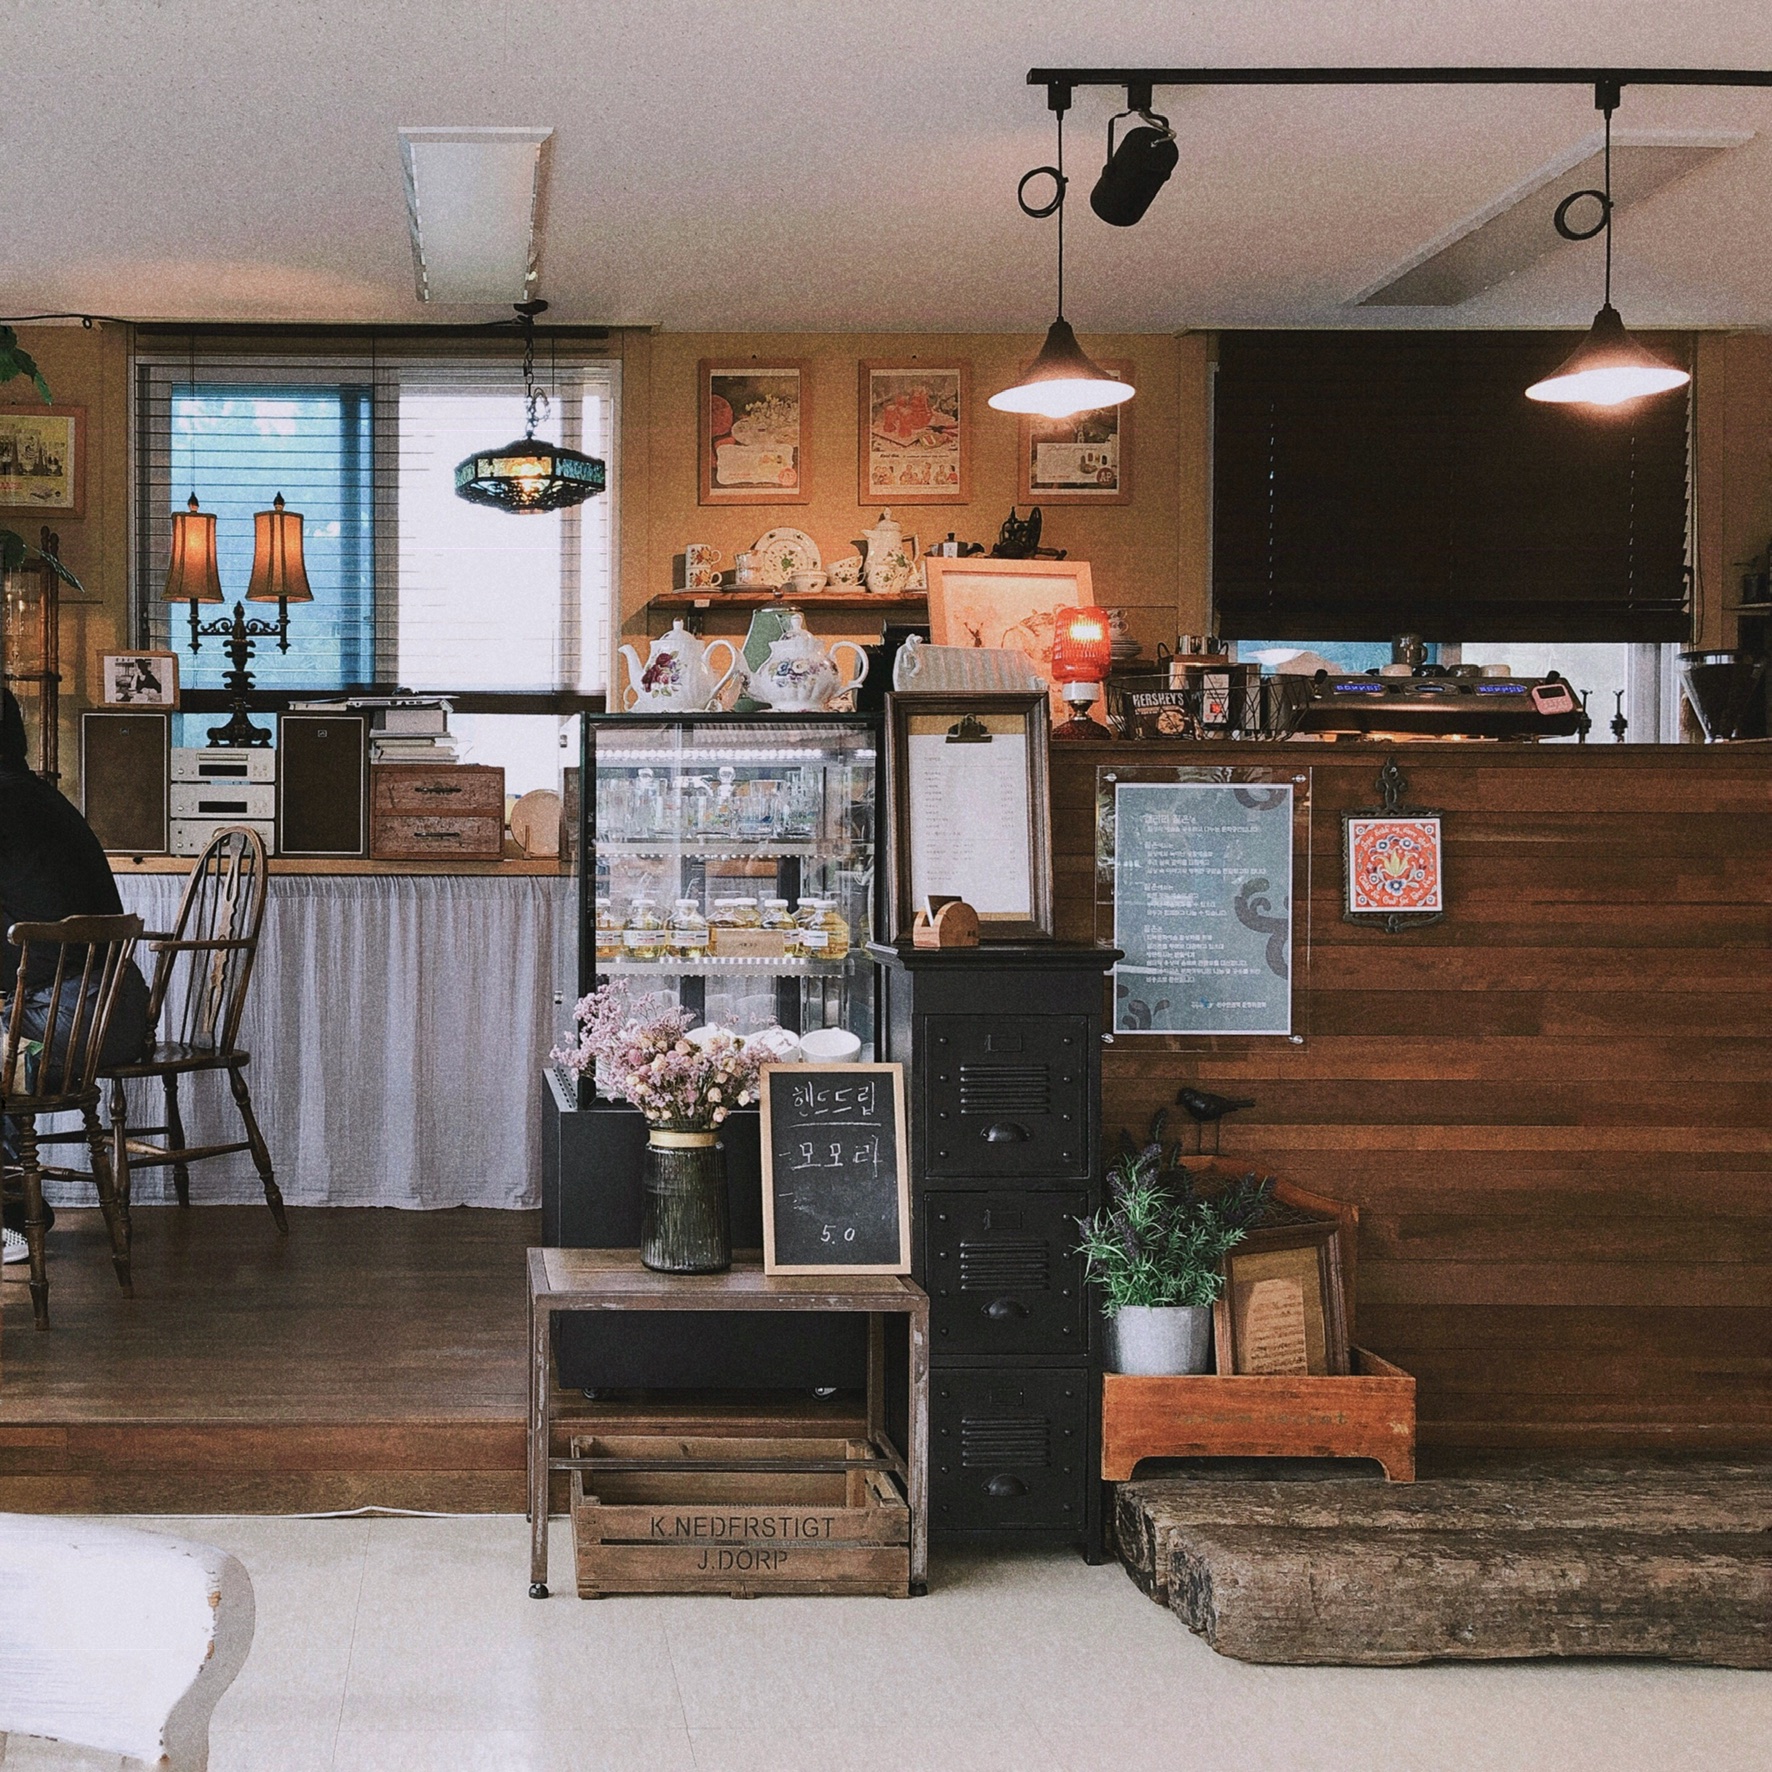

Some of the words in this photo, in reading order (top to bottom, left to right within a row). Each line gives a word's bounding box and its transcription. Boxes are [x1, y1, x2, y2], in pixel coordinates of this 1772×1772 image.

[1132, 692, 1184, 708] HERSHEY'S
[792, 1081, 875, 1117] 핸드드립
[697, 1550, 788, 1571] J.DORP
